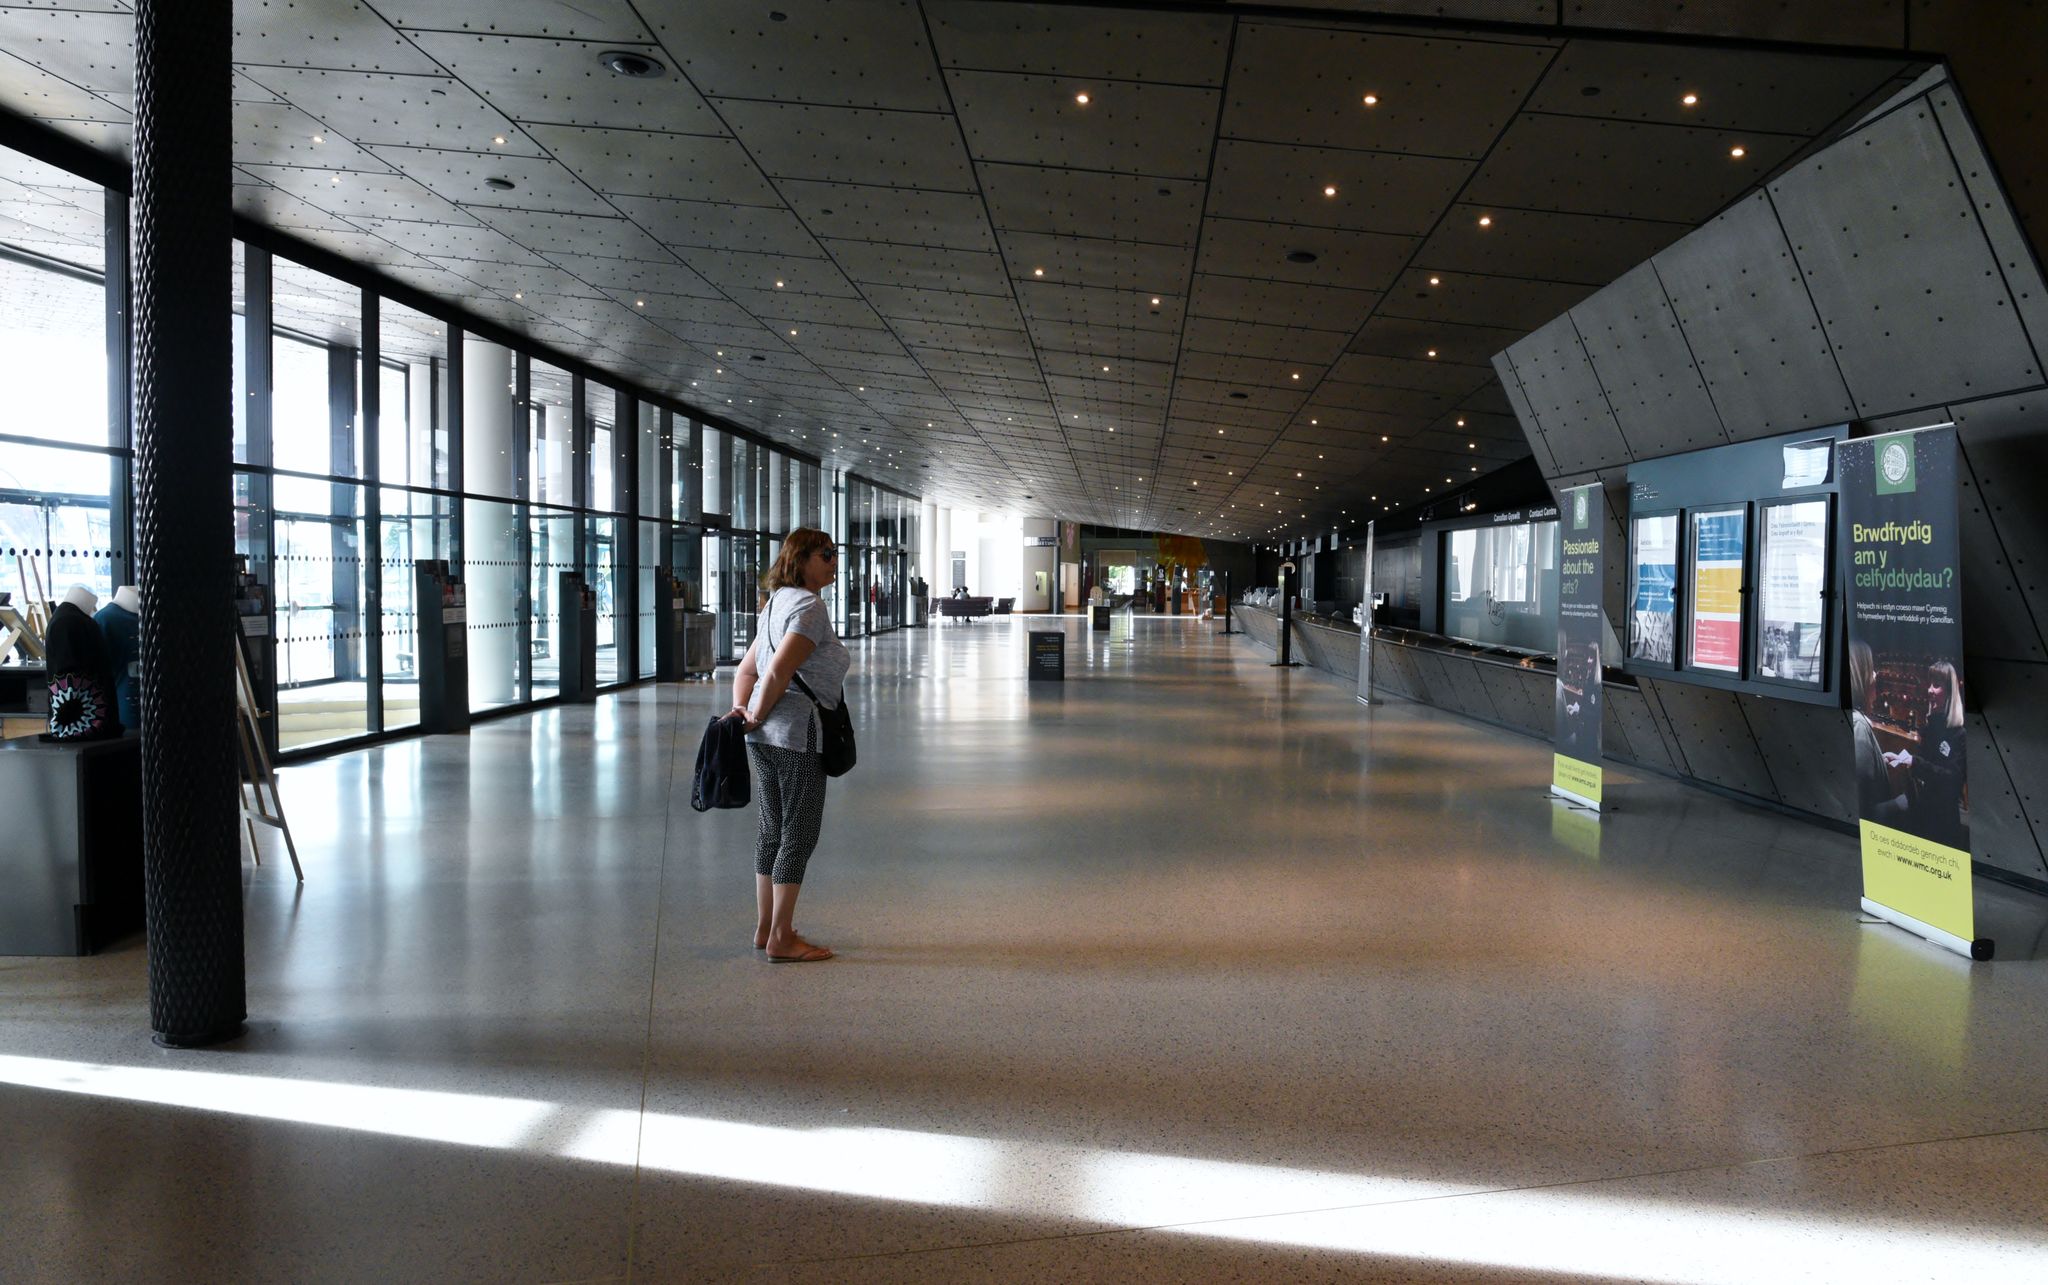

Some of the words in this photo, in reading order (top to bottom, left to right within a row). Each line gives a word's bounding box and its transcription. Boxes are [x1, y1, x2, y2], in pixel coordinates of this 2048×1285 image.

[1853, 520, 1932, 546] Brwdfrydig
[1563, 538, 1599, 555] Passionate
[1562, 560, 1582, 575] about
[1582, 558, 1594, 574] the
[1854, 550, 1876, 565] am
[1879, 550, 1888, 568] y
[1562, 578, 1578, 594] arts?
[1855, 567, 1953, 592] celfyddydau?
[1896, 855, 1952, 880] www.wmc.org.uk
